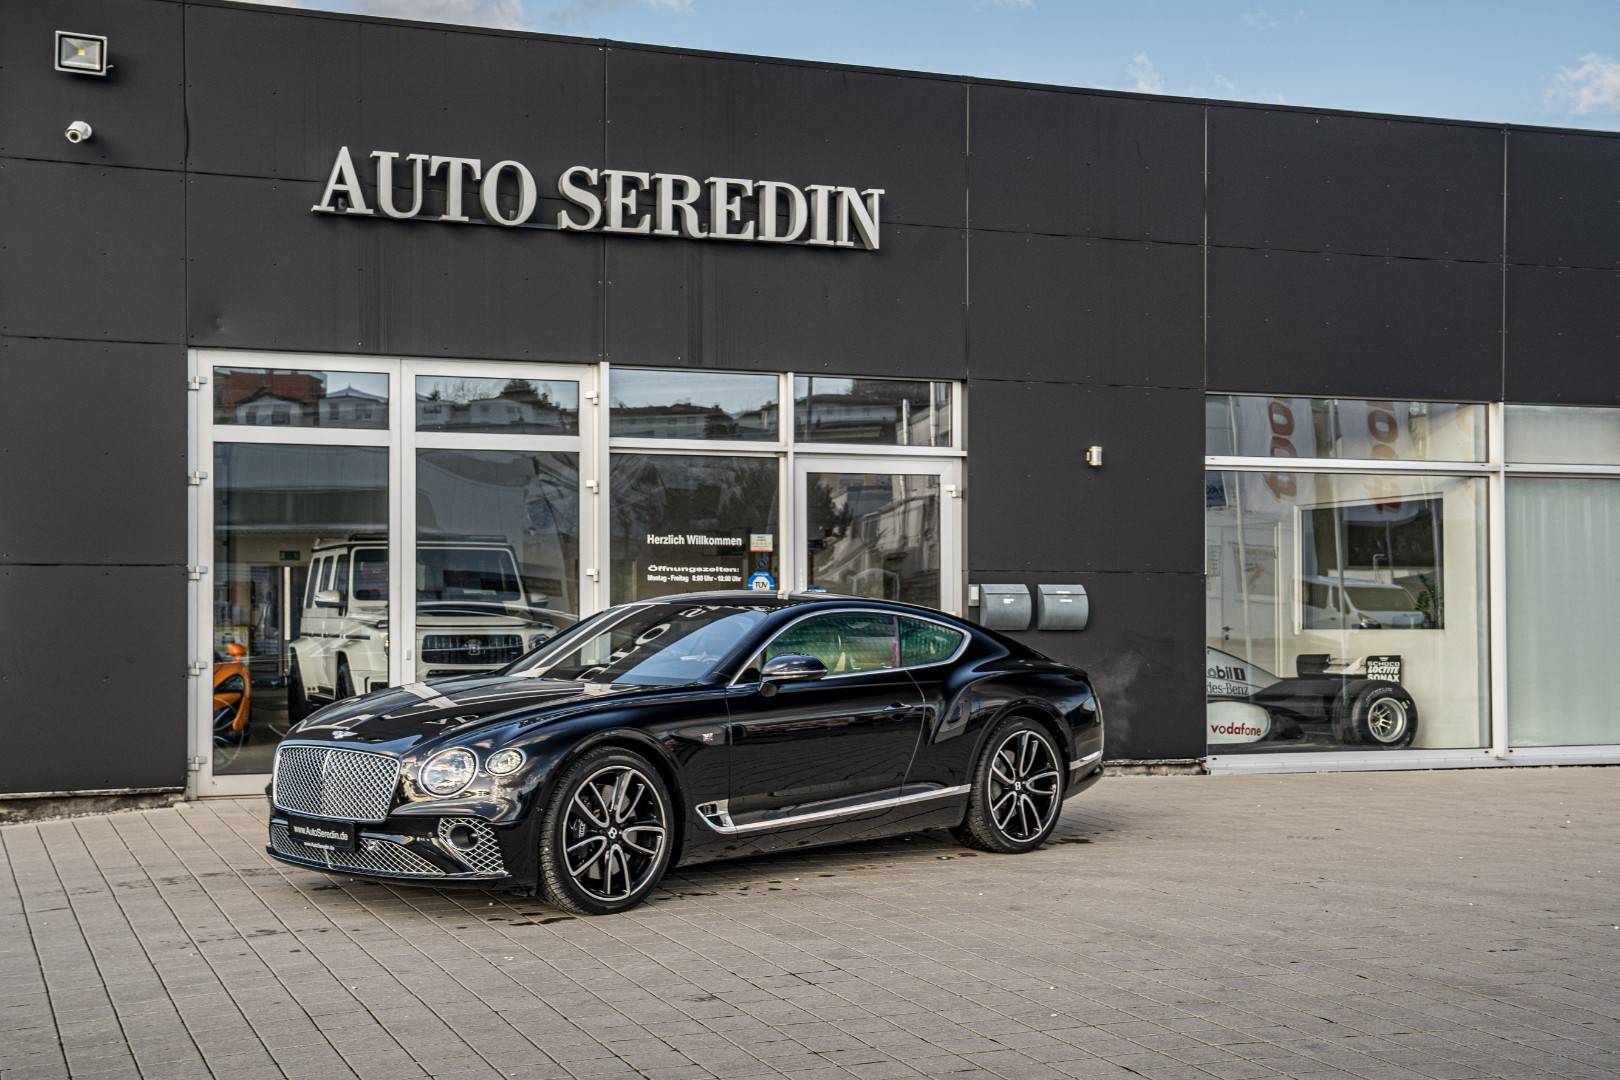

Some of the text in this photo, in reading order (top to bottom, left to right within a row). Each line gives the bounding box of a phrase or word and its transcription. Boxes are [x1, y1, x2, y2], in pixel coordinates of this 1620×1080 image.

[311, 146, 886, 250] AUTO SEREDIN
[647, 534, 685, 545] Herzlich
[687, 535, 742, 546] Willkommen
[1207, 665, 1233, 679] obil
[1367, 666, 1400, 674] LOCTITE
[1367, 673, 1400, 682] SONAX
[1210, 722, 1262, 736] vodafone
